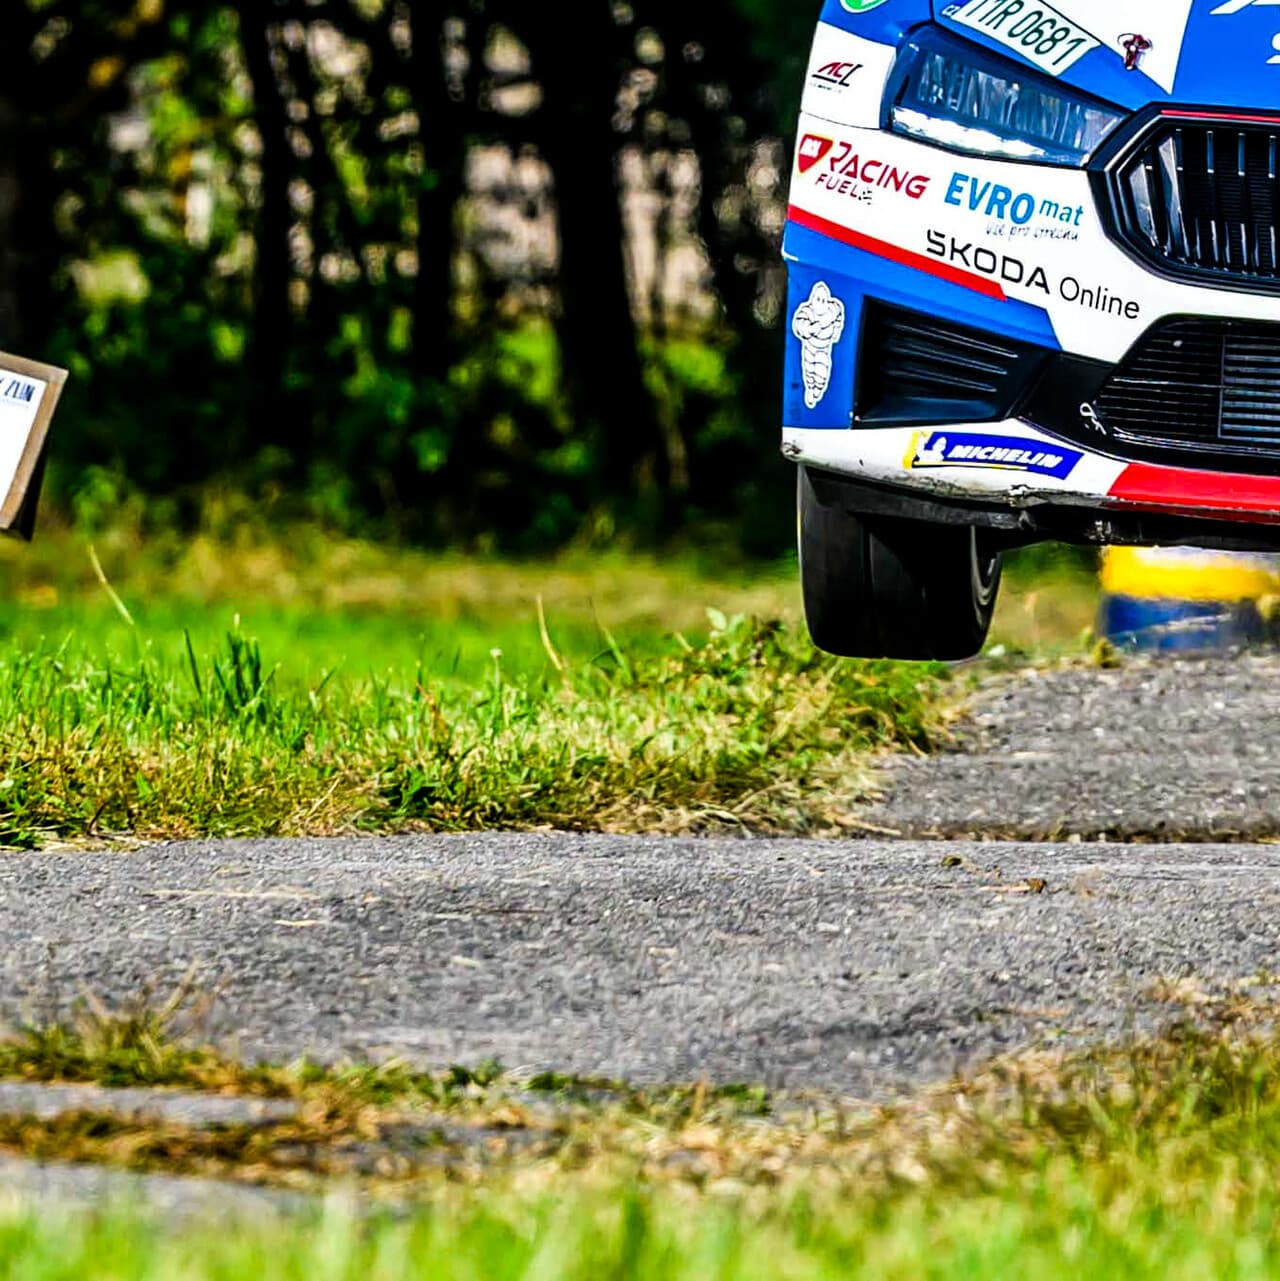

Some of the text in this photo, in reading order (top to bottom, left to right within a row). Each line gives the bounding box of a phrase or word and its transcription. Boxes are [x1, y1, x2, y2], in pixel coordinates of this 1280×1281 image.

[1007, 10, 1087, 66] 0681
[830, 141, 931, 199] RACING
[944, 172, 1084, 227] EVRO mat
[1059, 276, 1140, 319] Online
[947, 445, 1063, 468] MICHELIN
